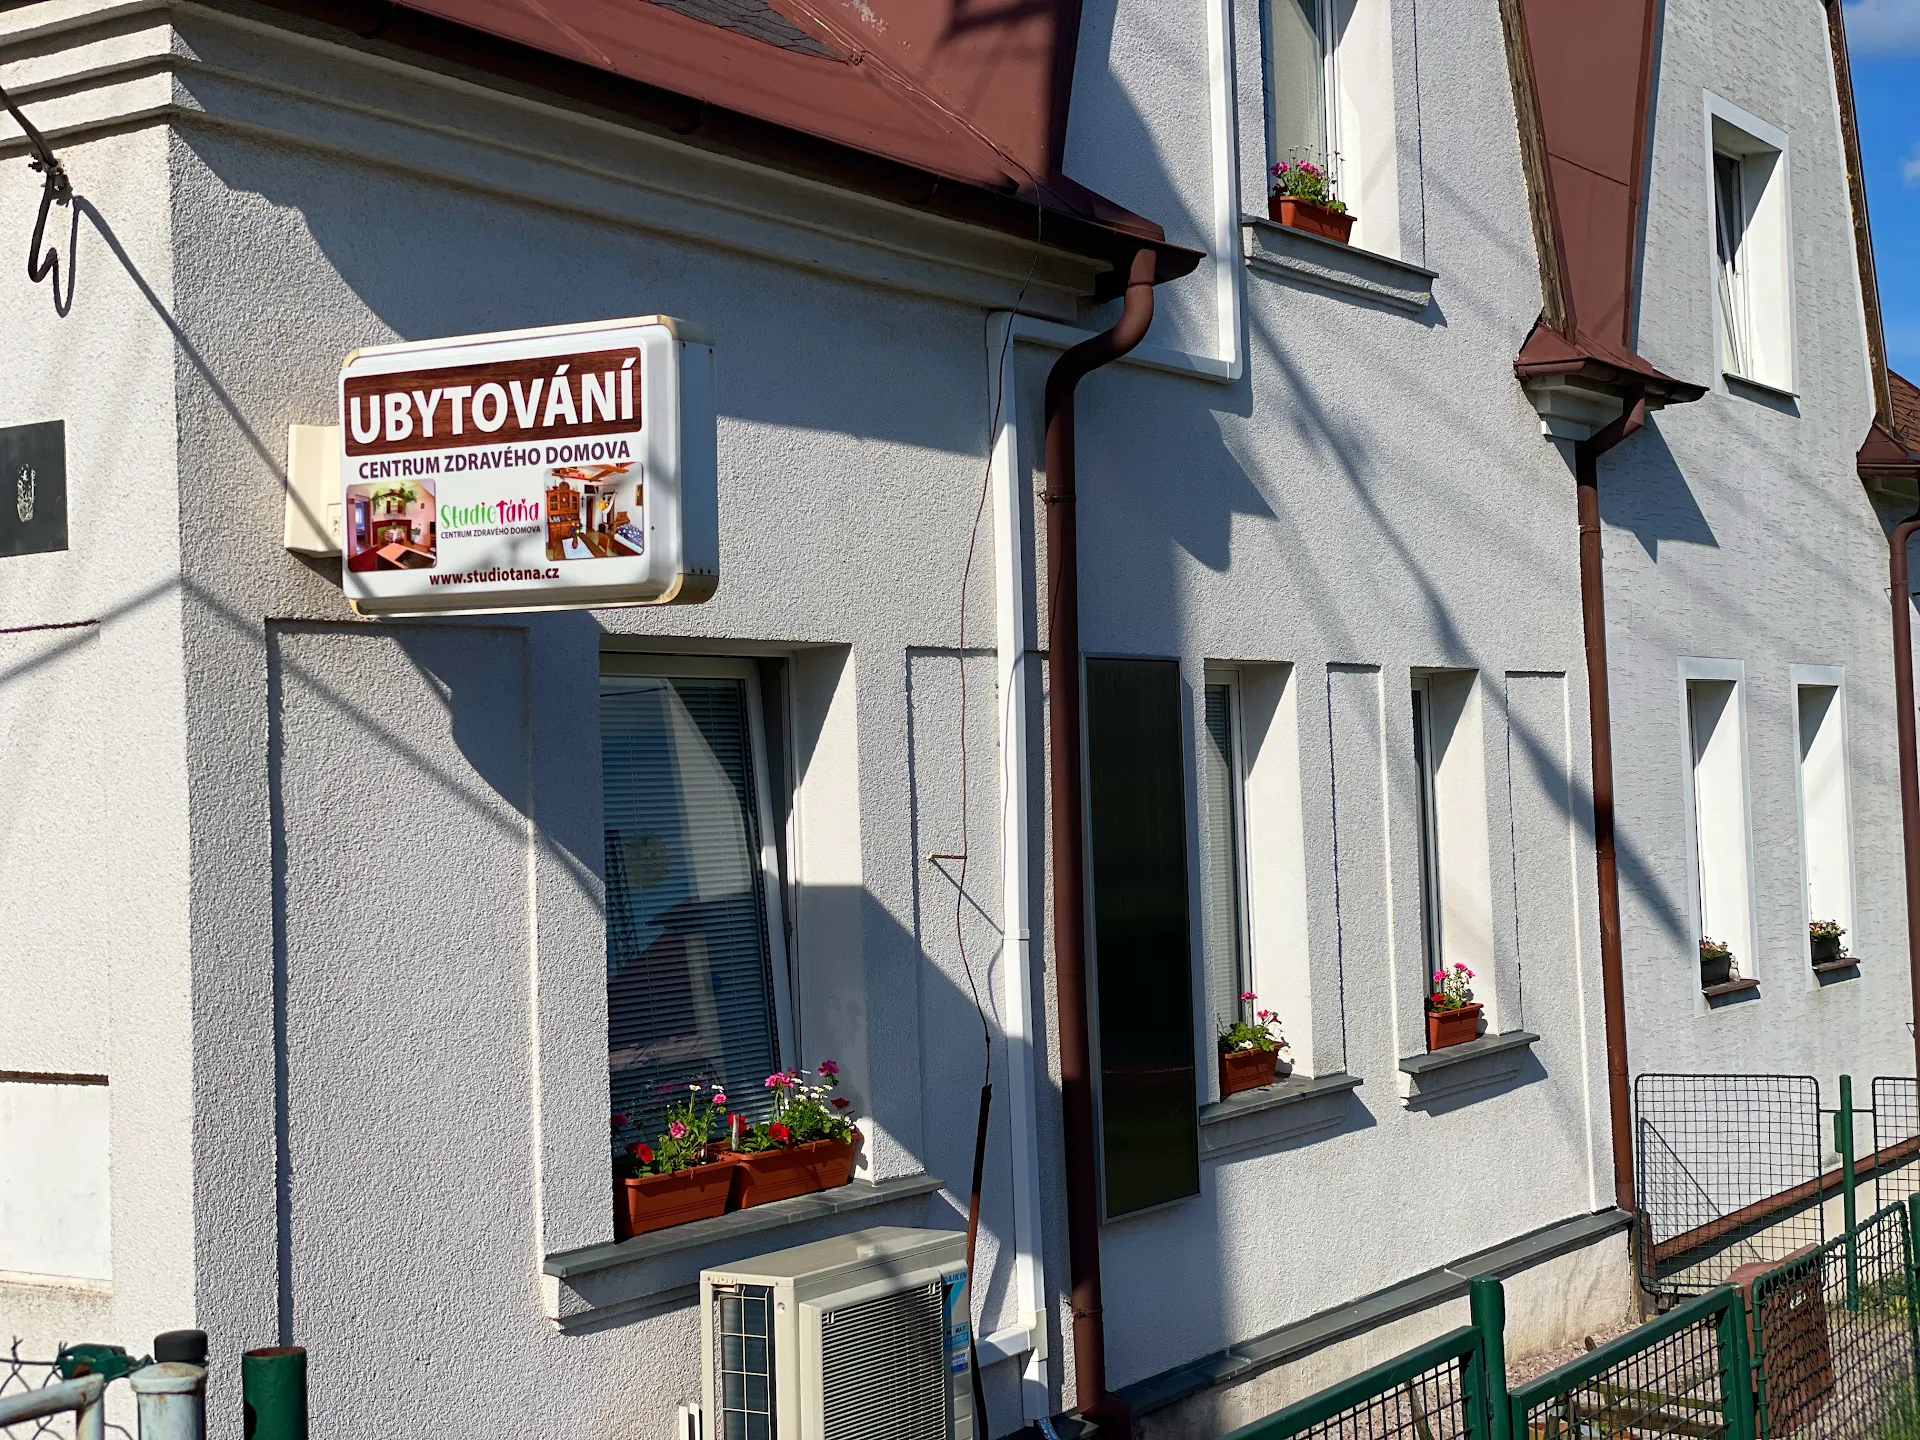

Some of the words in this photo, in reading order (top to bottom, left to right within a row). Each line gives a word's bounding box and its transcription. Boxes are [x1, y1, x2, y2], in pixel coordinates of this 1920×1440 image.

[350, 357, 637, 444] UBYTOVÁNÍ
[358, 456, 440, 479] CENTRUM
[444, 446, 541, 473] ZDRAVÉHO
[545, 440, 631, 464] DOMOVA
[440, 529, 472, 539] CENTRUM
[473, 527, 509, 537] ZDRAVÉHO
[510, 525, 541, 535] DOMOVA
[429, 566, 560, 586] www.studiotana.cz
